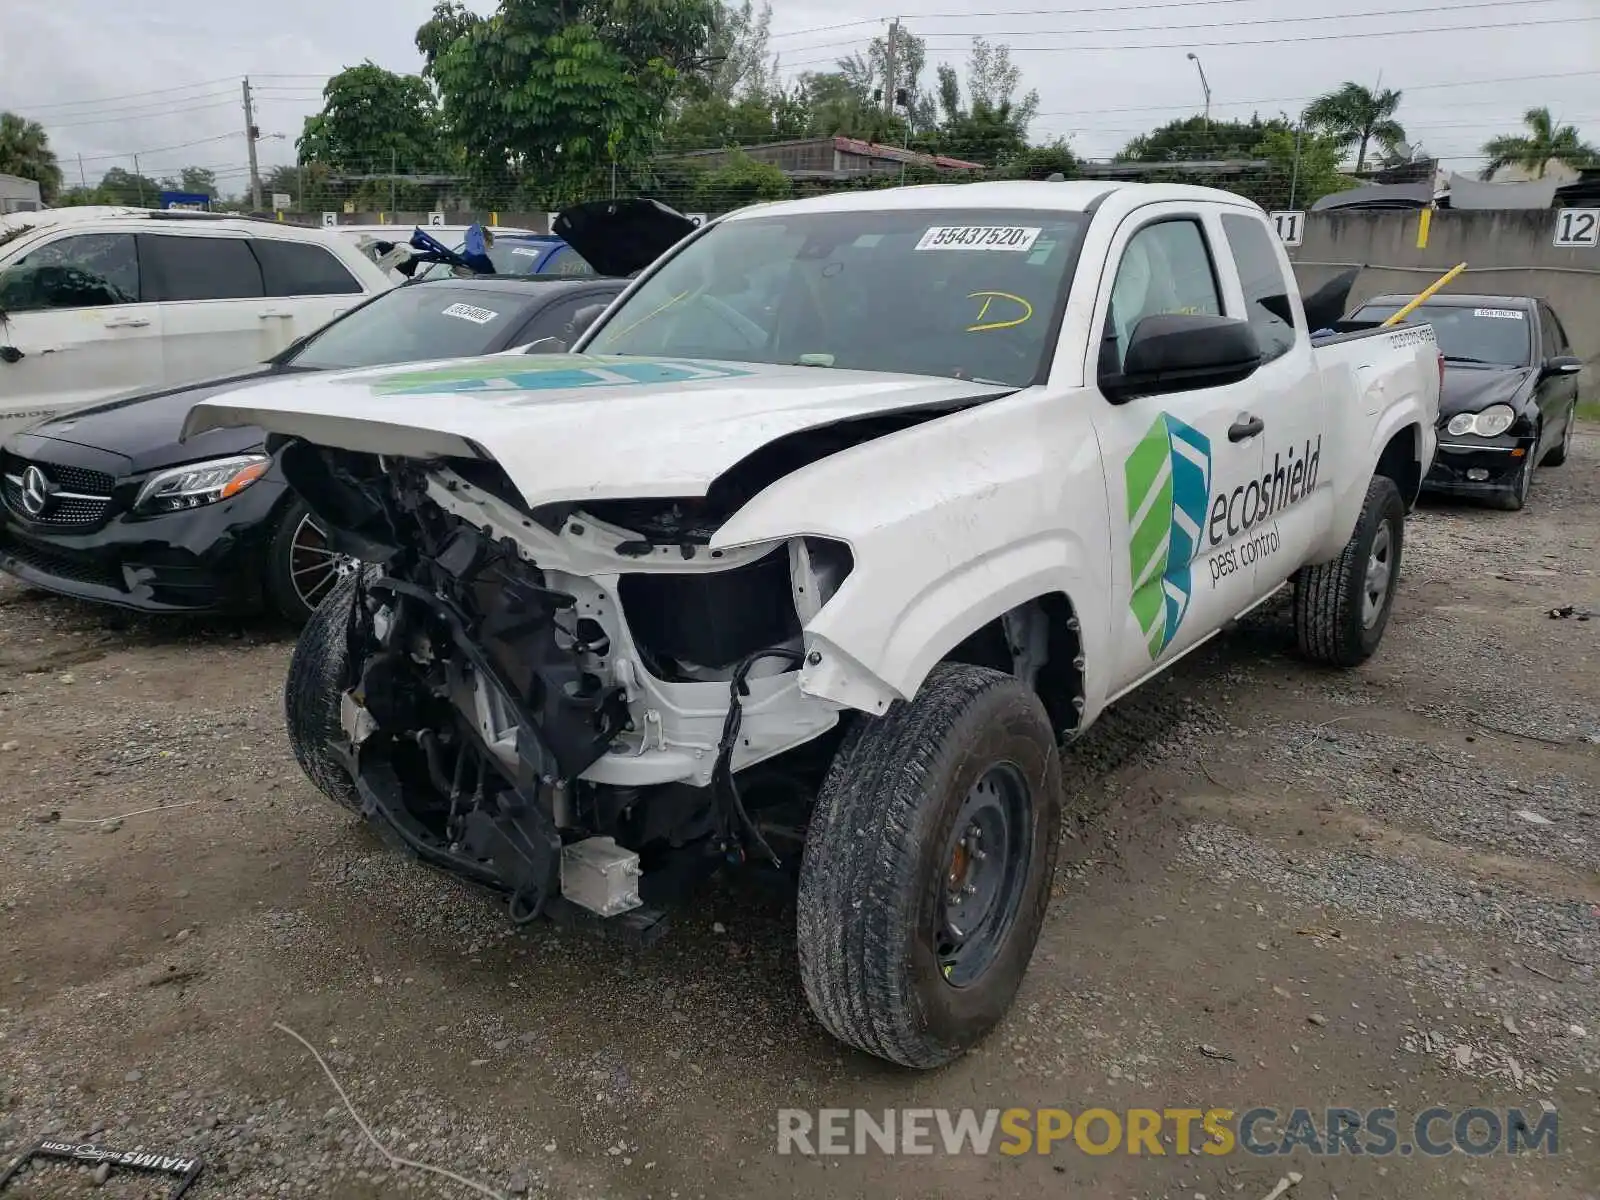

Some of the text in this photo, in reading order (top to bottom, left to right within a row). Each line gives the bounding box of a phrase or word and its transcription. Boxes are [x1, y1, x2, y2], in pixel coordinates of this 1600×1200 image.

[1275, 215, 1297, 241] 11
[1560, 213, 1595, 241] 12
[966, 291, 1032, 331] D
[1209, 434, 1321, 546] ecoshield
[1208, 522, 1281, 589] pest control
